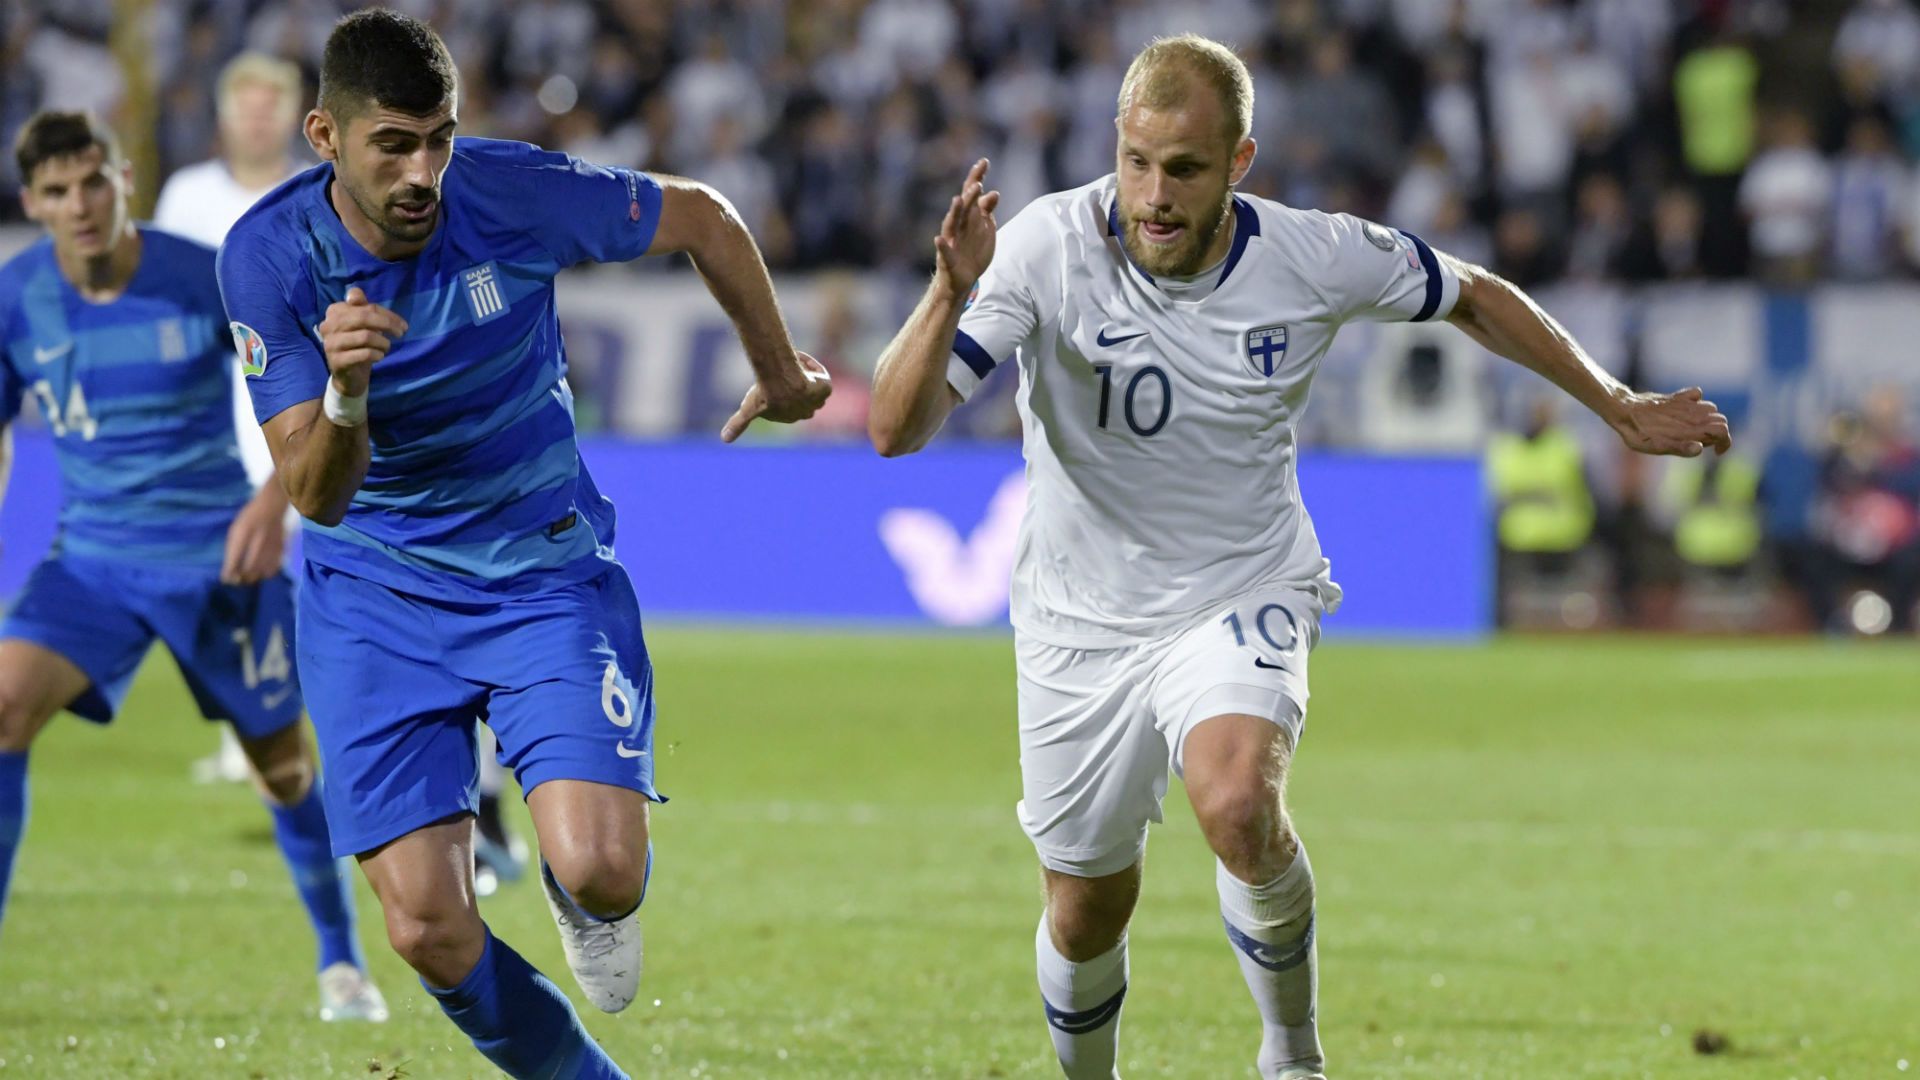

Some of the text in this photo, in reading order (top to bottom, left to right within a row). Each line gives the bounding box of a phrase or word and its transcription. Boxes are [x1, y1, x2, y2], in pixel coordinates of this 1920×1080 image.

[33, 380, 97, 441] 14
[1094, 365, 1171, 437] 10
[232, 624, 290, 690] 14
[1222, 603, 1298, 651] 10
[602, 662, 632, 727] 6
